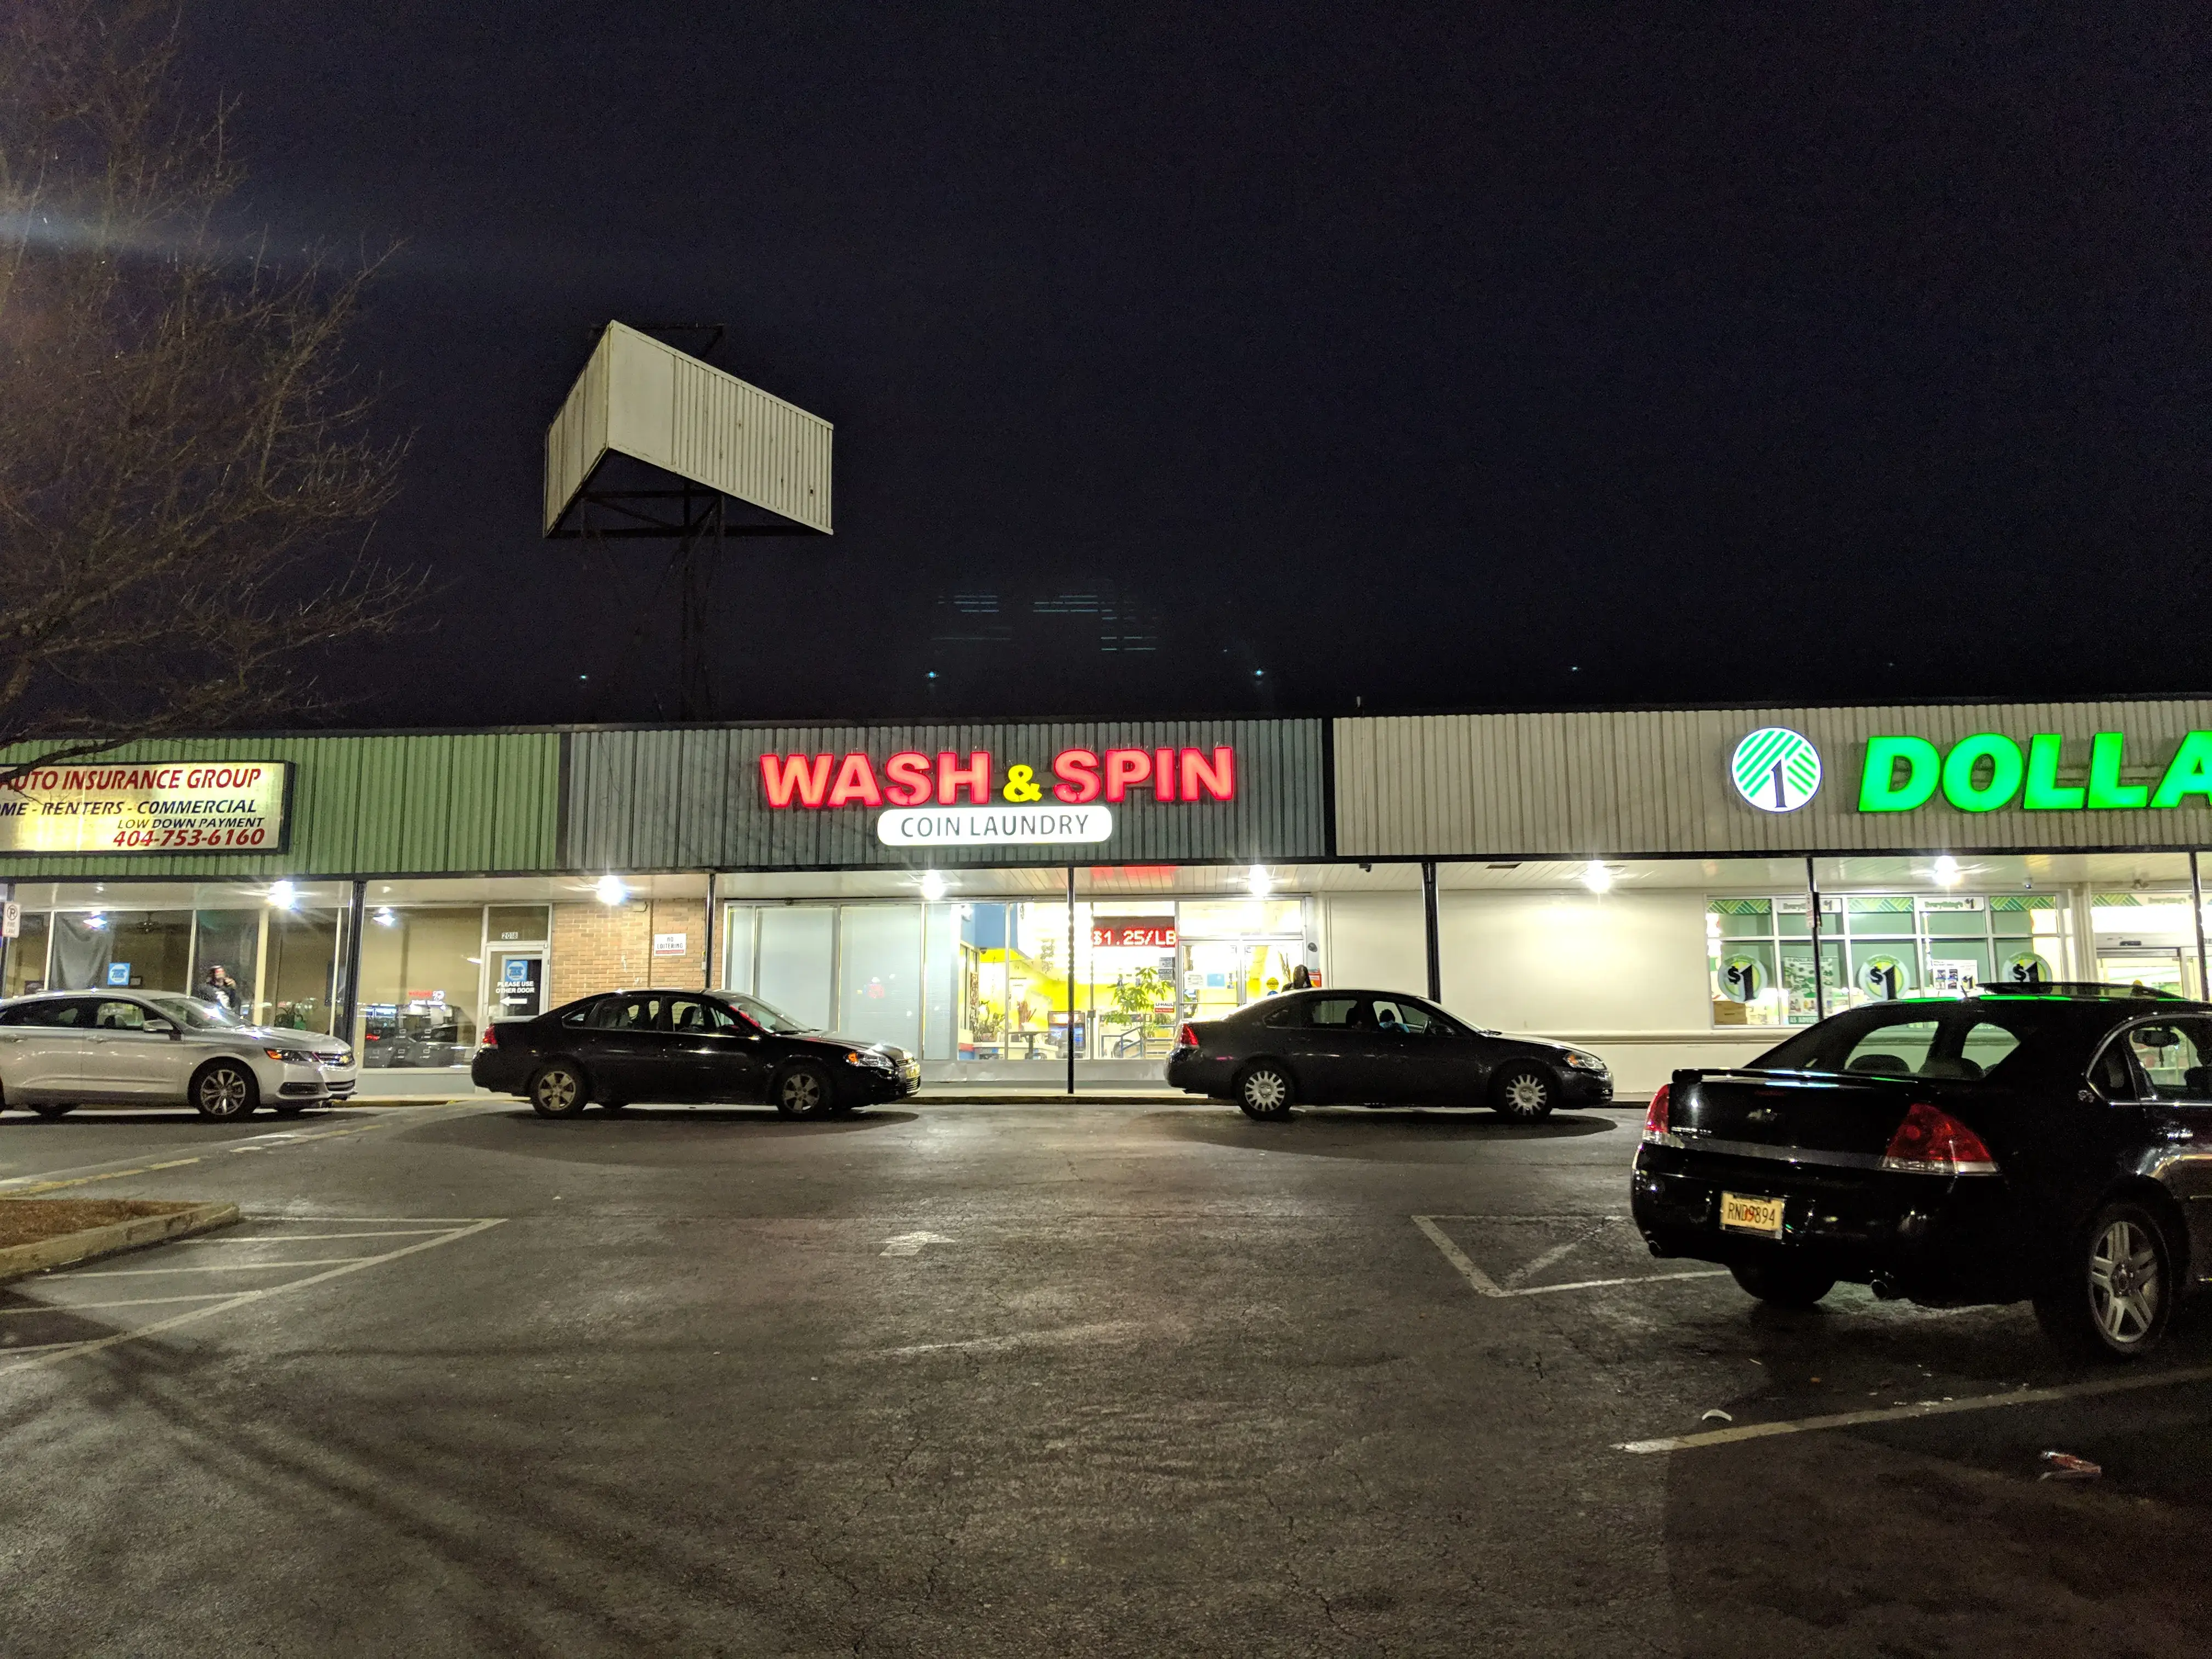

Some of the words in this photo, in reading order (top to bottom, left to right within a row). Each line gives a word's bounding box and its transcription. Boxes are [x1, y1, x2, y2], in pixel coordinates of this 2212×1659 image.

[61, 769, 183, 790] INSURANCE
[187, 768, 261, 788] GROUP
[759, 752, 990, 808] WASH
[1003, 763, 1043, 803] &
[1053, 746, 1234, 805] SPIN
[1858, 730, 2212, 812] DOLLA
[0, 801, 29, 816] ME
[41, 802, 125, 815] RENTERS
[137, 799, 257, 814] COMMERCIAL
[117, 819, 149, 829] LOW
[151, 819, 197, 828] DOWN
[199, 817, 265, 828] PAYMENT
[901, 816, 960, 838] COIN
[970, 814, 1090, 837] LAUNDRY
[113, 828, 266, 847] 404-753-6160
[1093, 930, 1176, 945] $1.25/LB
[1728, 1202, 1776, 1226] RND9894
